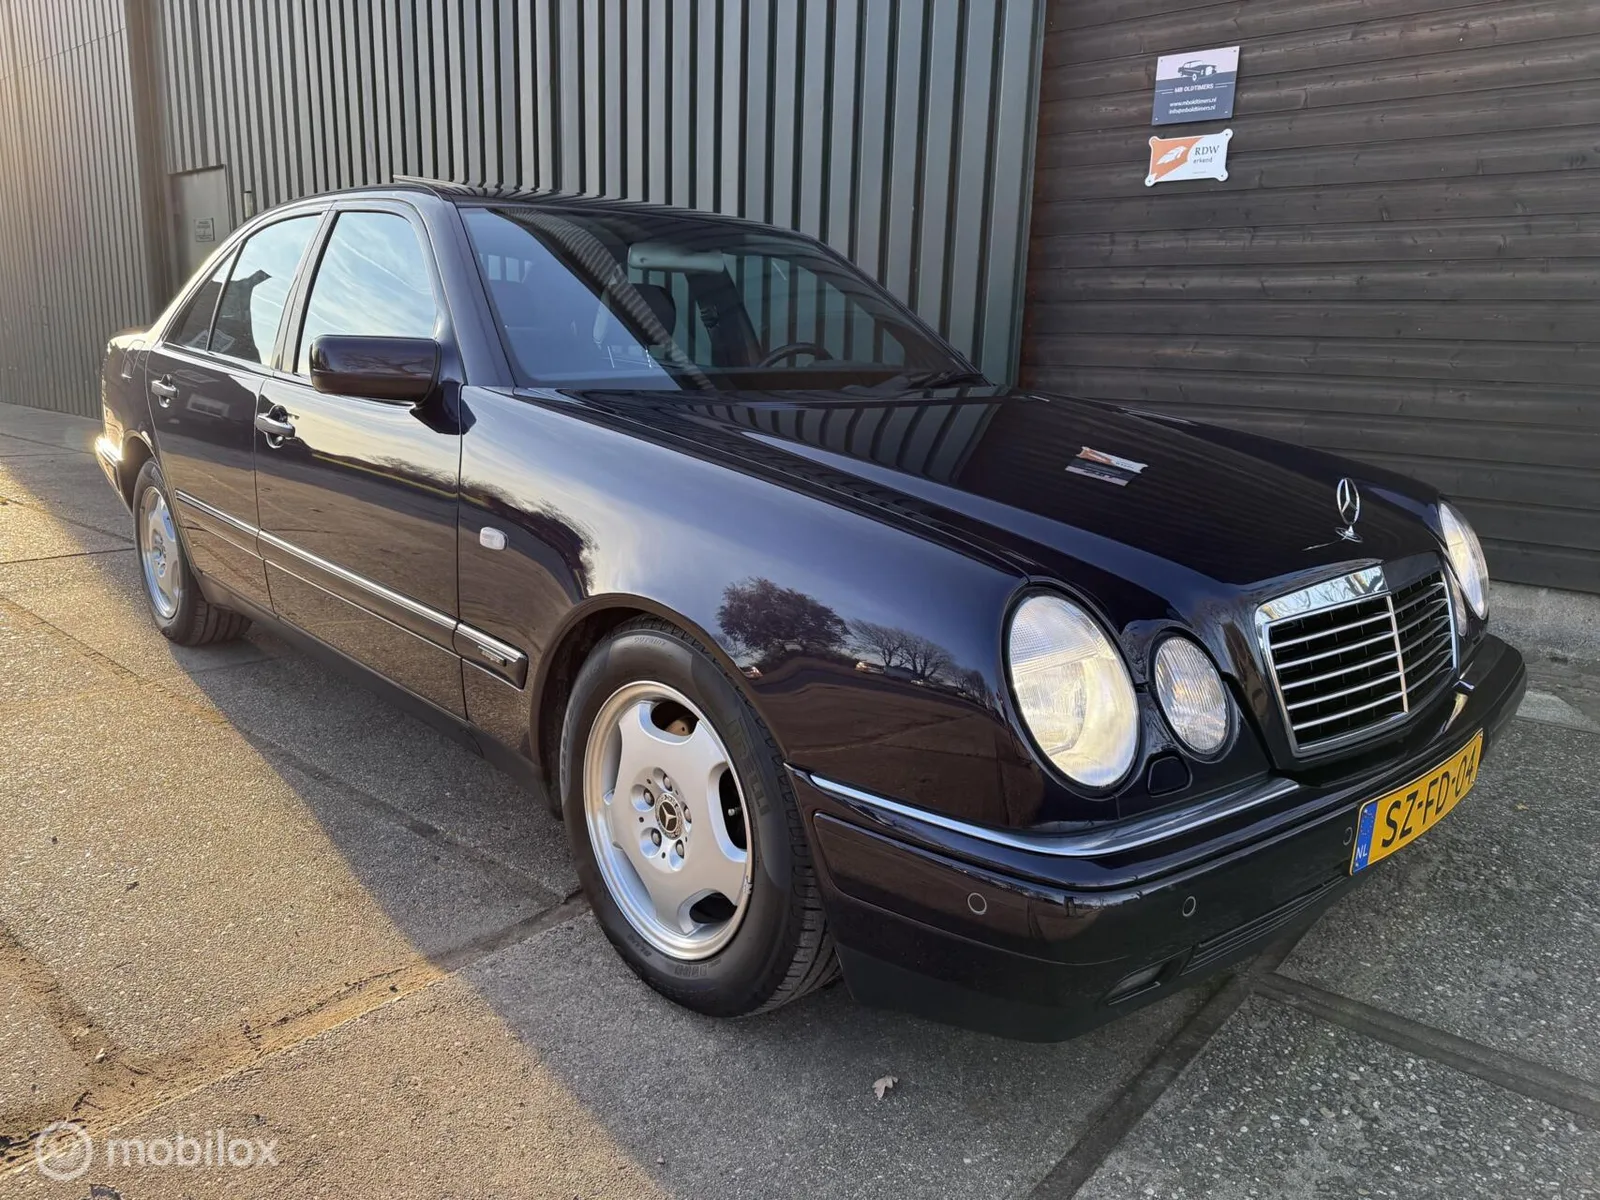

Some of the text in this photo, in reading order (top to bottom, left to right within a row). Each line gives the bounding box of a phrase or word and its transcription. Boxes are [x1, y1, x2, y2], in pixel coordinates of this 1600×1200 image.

[1183, 83, 1214, 92] OLDTIMERS
[1169, 97, 1217, 107] www.mboldtimers.nl
[1194, 145, 1220, 156] RDW
[1356, 745, 1477, 860] NL SZ-FD-04
